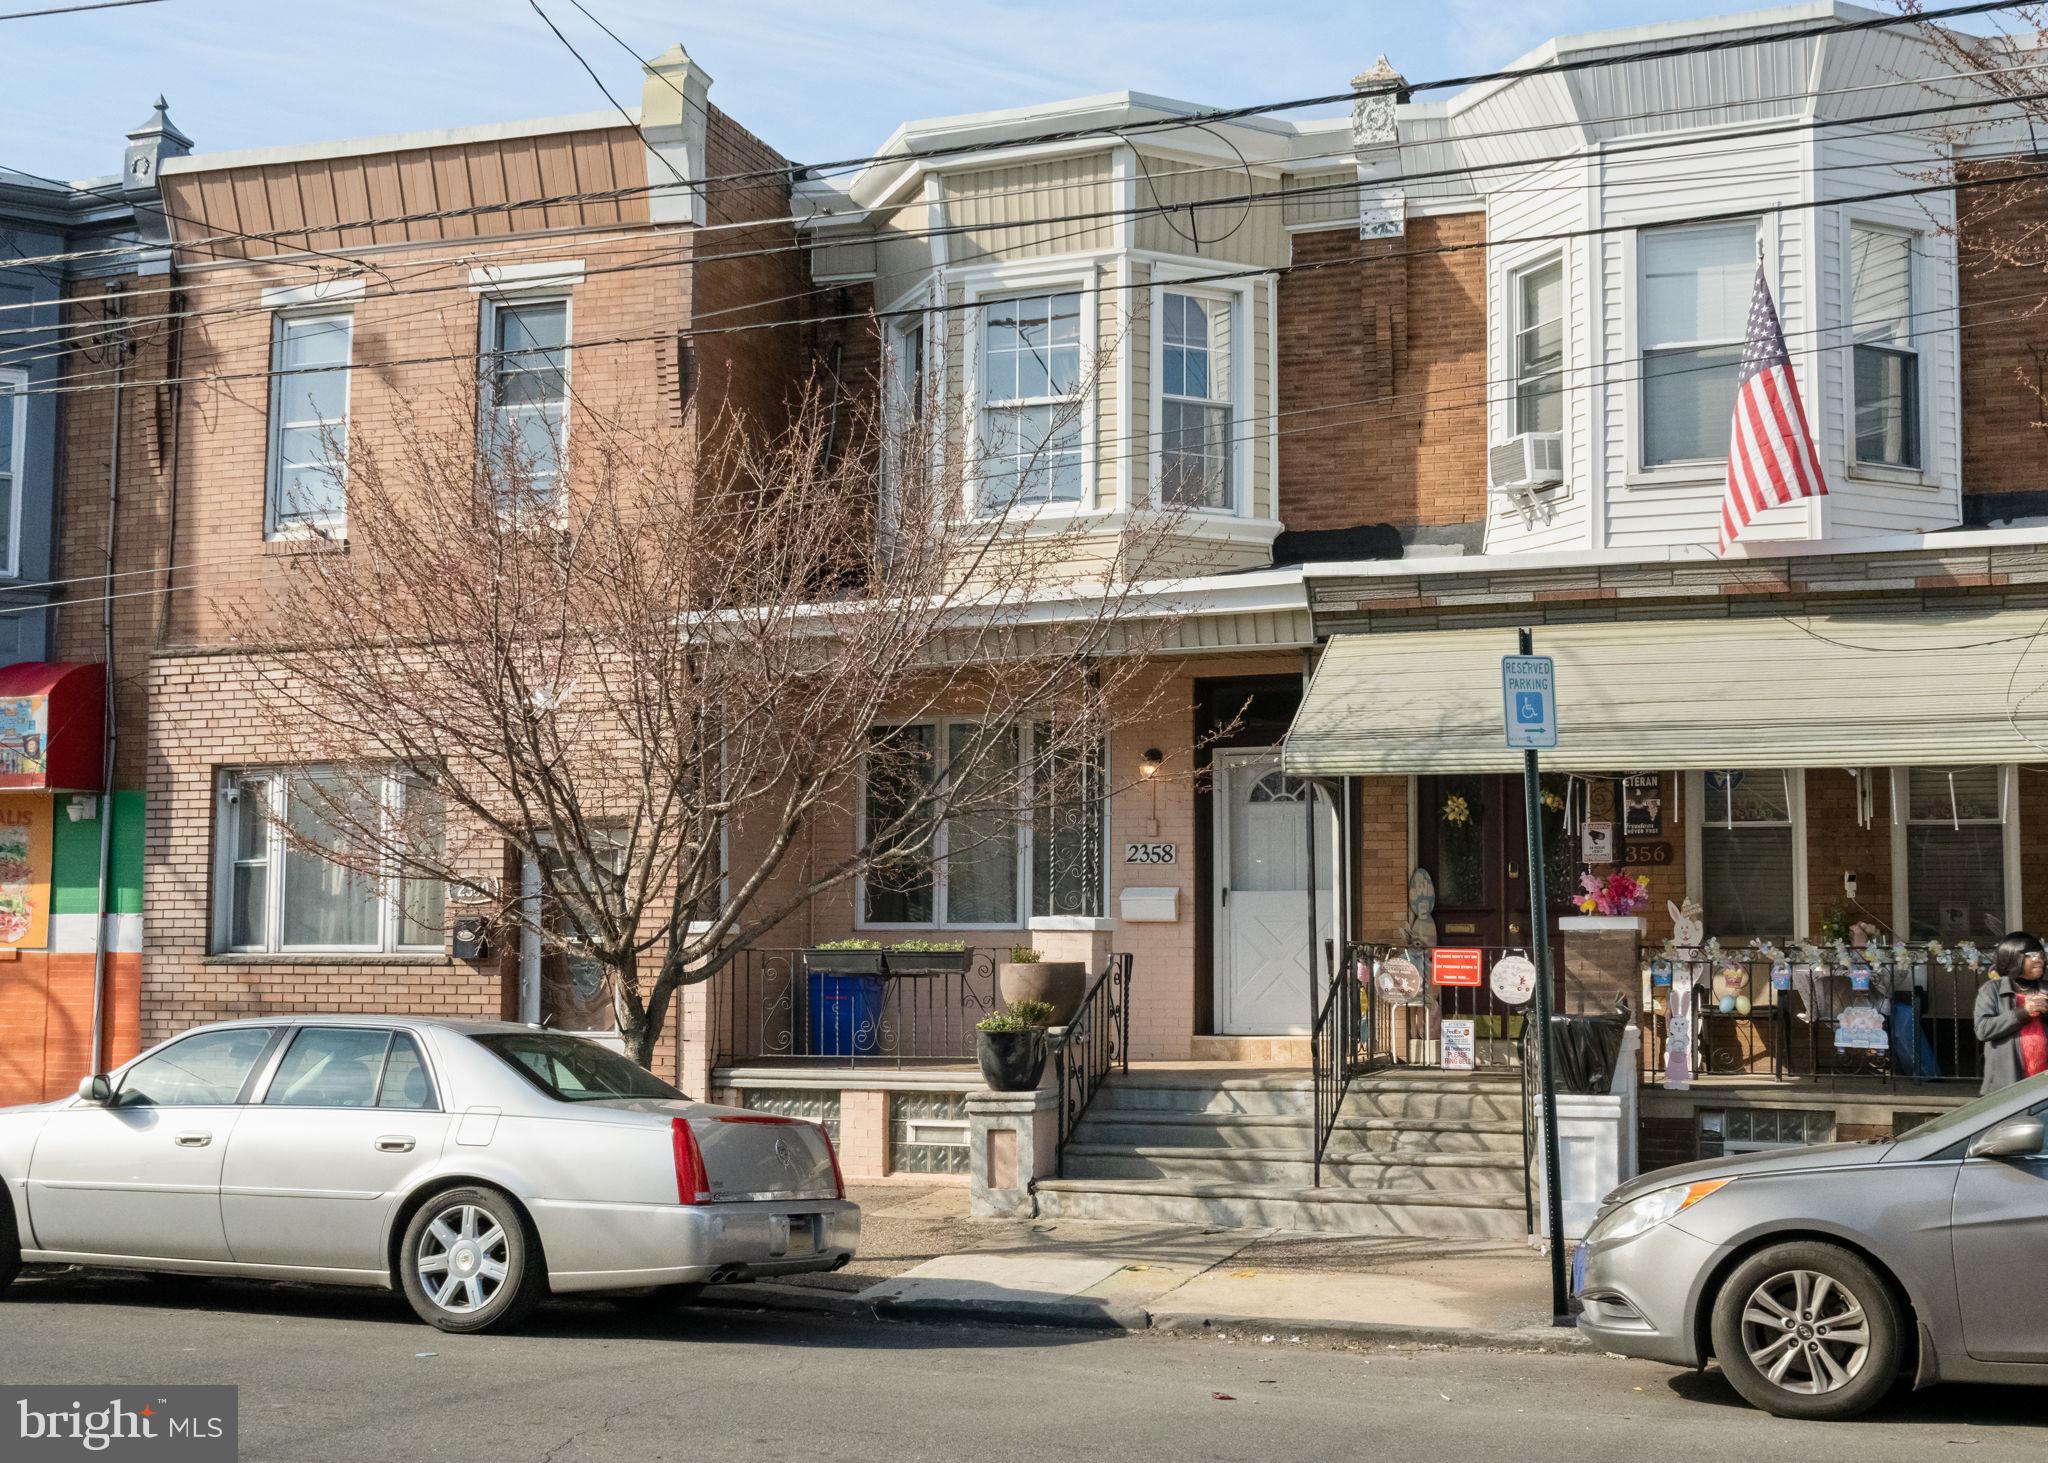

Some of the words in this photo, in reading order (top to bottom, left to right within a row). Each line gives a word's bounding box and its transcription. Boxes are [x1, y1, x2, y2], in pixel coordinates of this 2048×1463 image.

[1505, 662, 1550, 675] RESERVED
[1508, 678, 1549, 690] PARKING
[1623, 776, 1658, 787] ETERAN
[1126, 844, 1174, 864] 2358
[1625, 845, 1665, 863] 356
